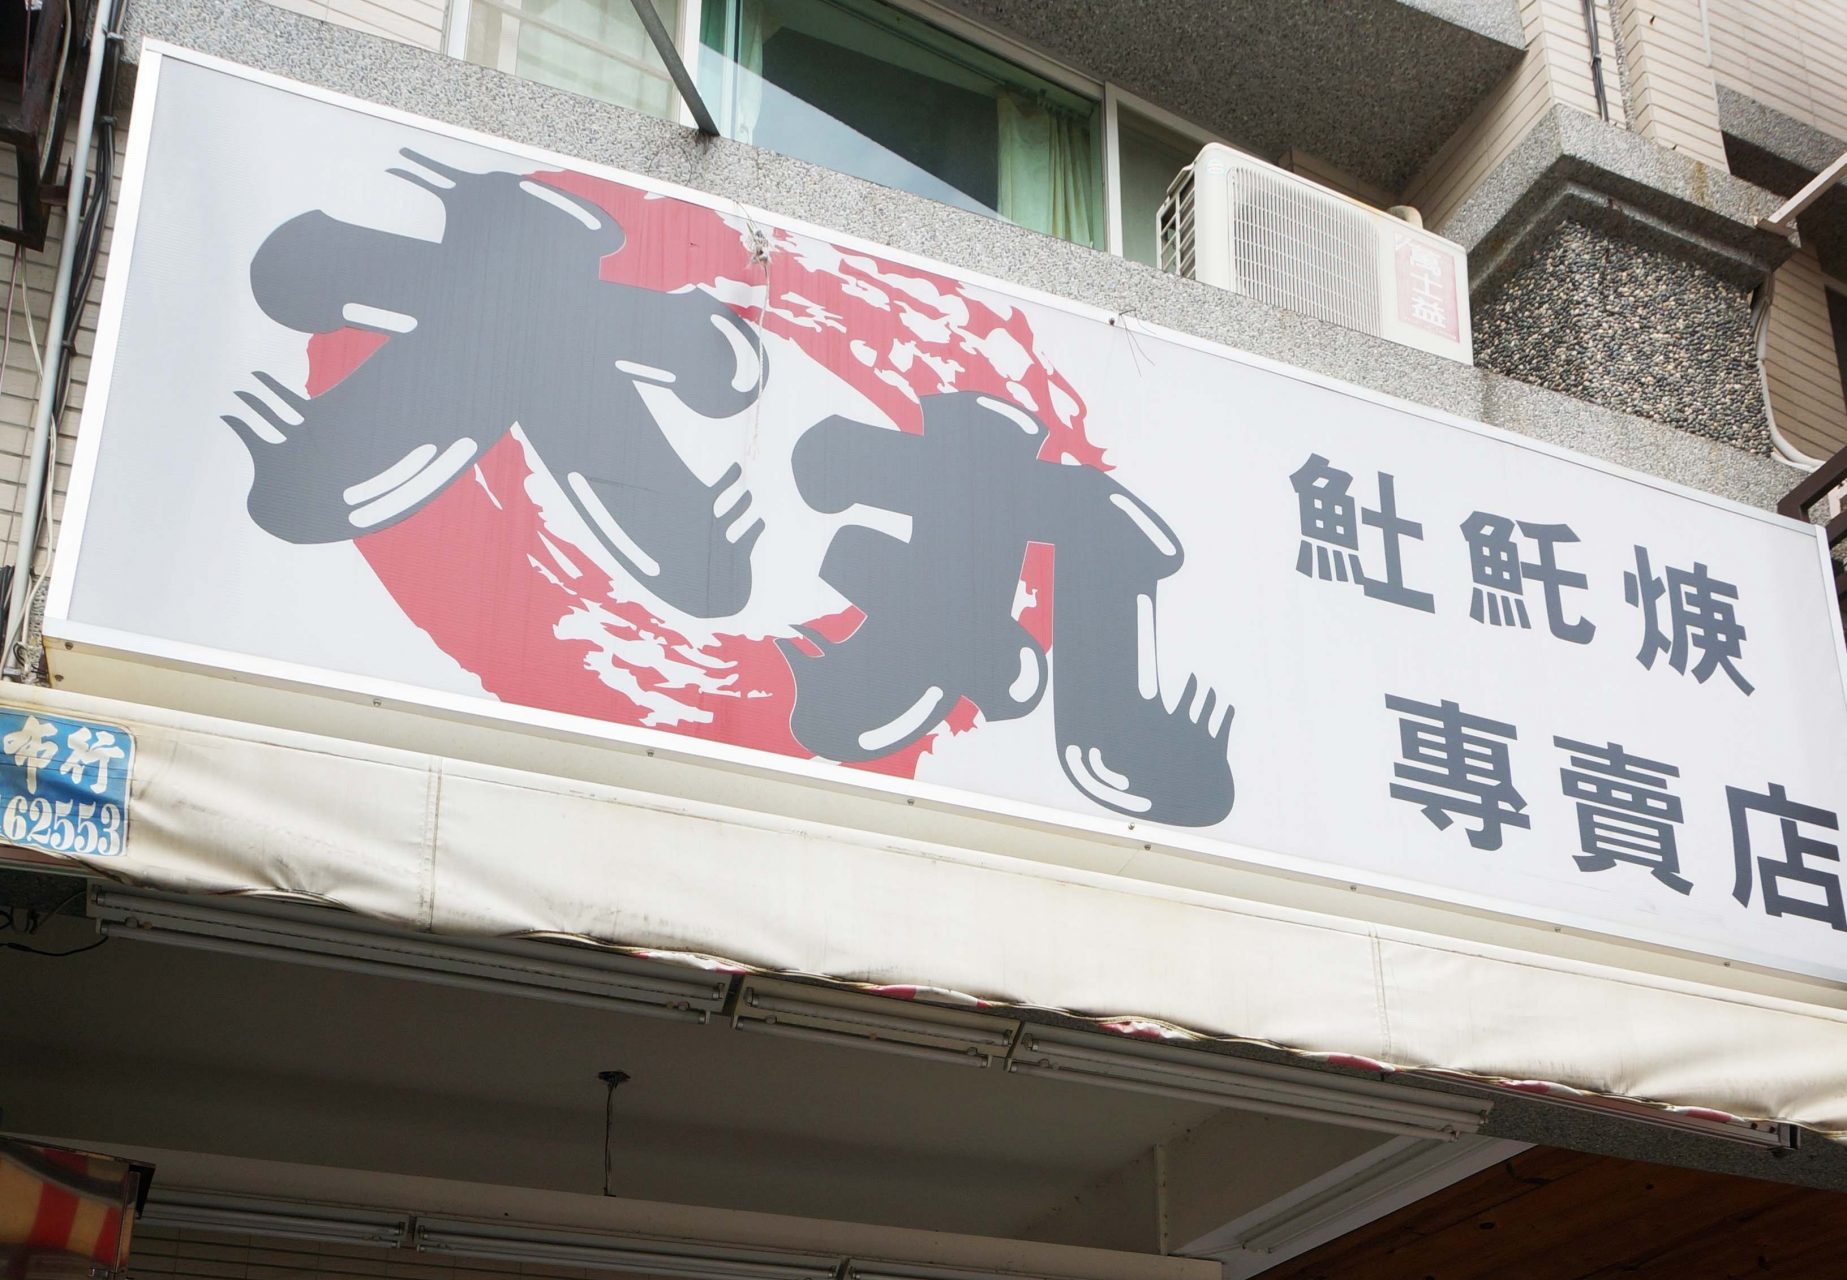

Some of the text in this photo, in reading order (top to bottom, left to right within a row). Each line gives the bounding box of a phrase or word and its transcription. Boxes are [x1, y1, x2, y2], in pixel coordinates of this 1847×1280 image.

[0, 796, 121, 856] 62553
[1385, 694, 1847, 932] 專賣店
